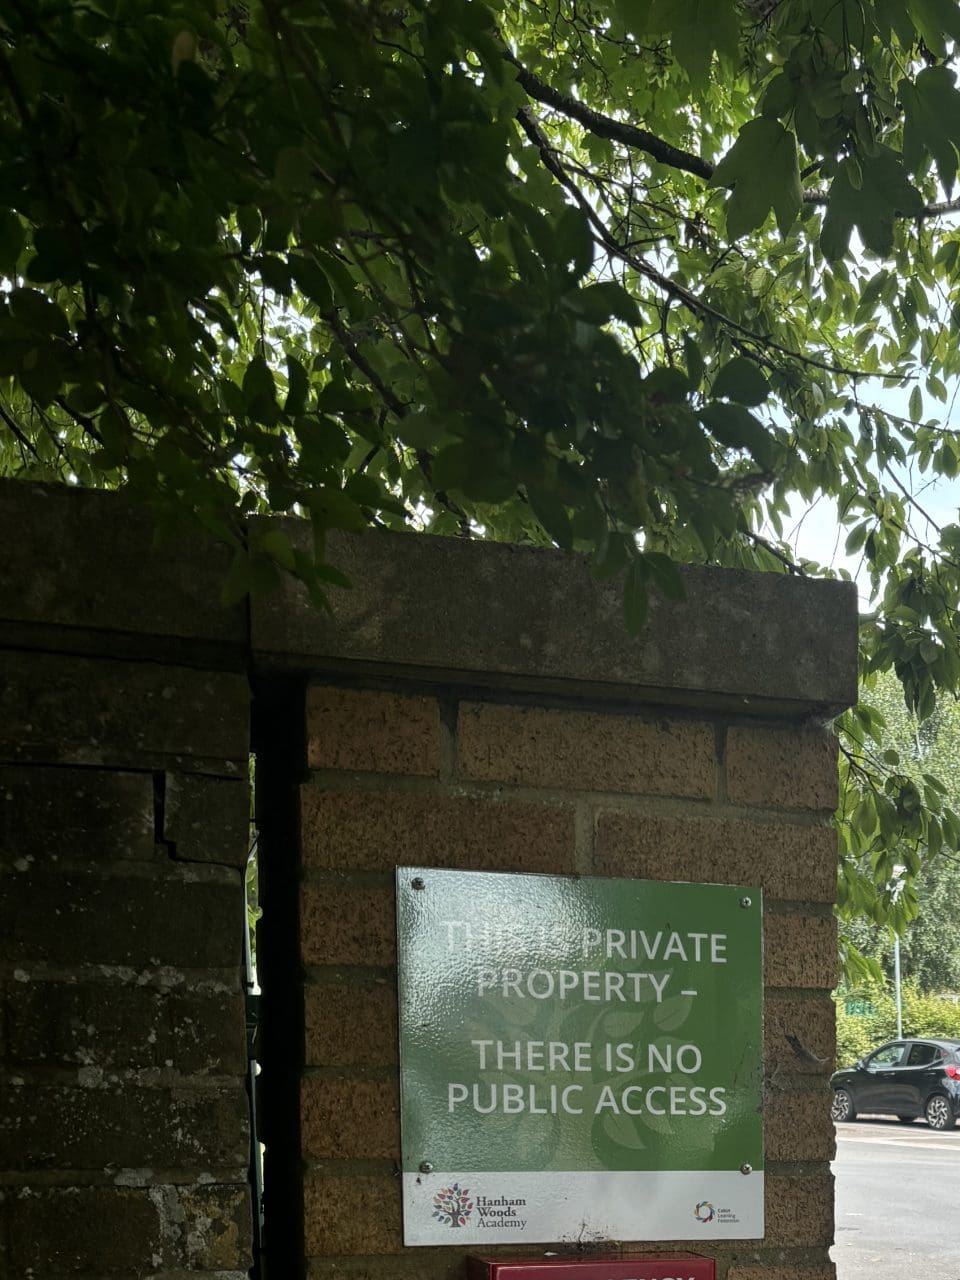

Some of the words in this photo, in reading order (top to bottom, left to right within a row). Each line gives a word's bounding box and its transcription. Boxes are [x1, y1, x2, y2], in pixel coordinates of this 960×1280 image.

[583, 928, 728, 963] PRIVATE
[477, 968, 670, 1003] PROPERTY
[471, 1040, 592, 1072] THERE
[604, 1042, 635, 1073] IS
[647, 1044, 702, 1074] NO
[447, 1083, 583, 1114] PUBLIC
[593, 1085, 728, 1116] ACCESS
[475, 1195, 526, 1206] Hanham
[475, 1206, 517, 1216] Woods
[476, 1216, 528, 1230] Academy
